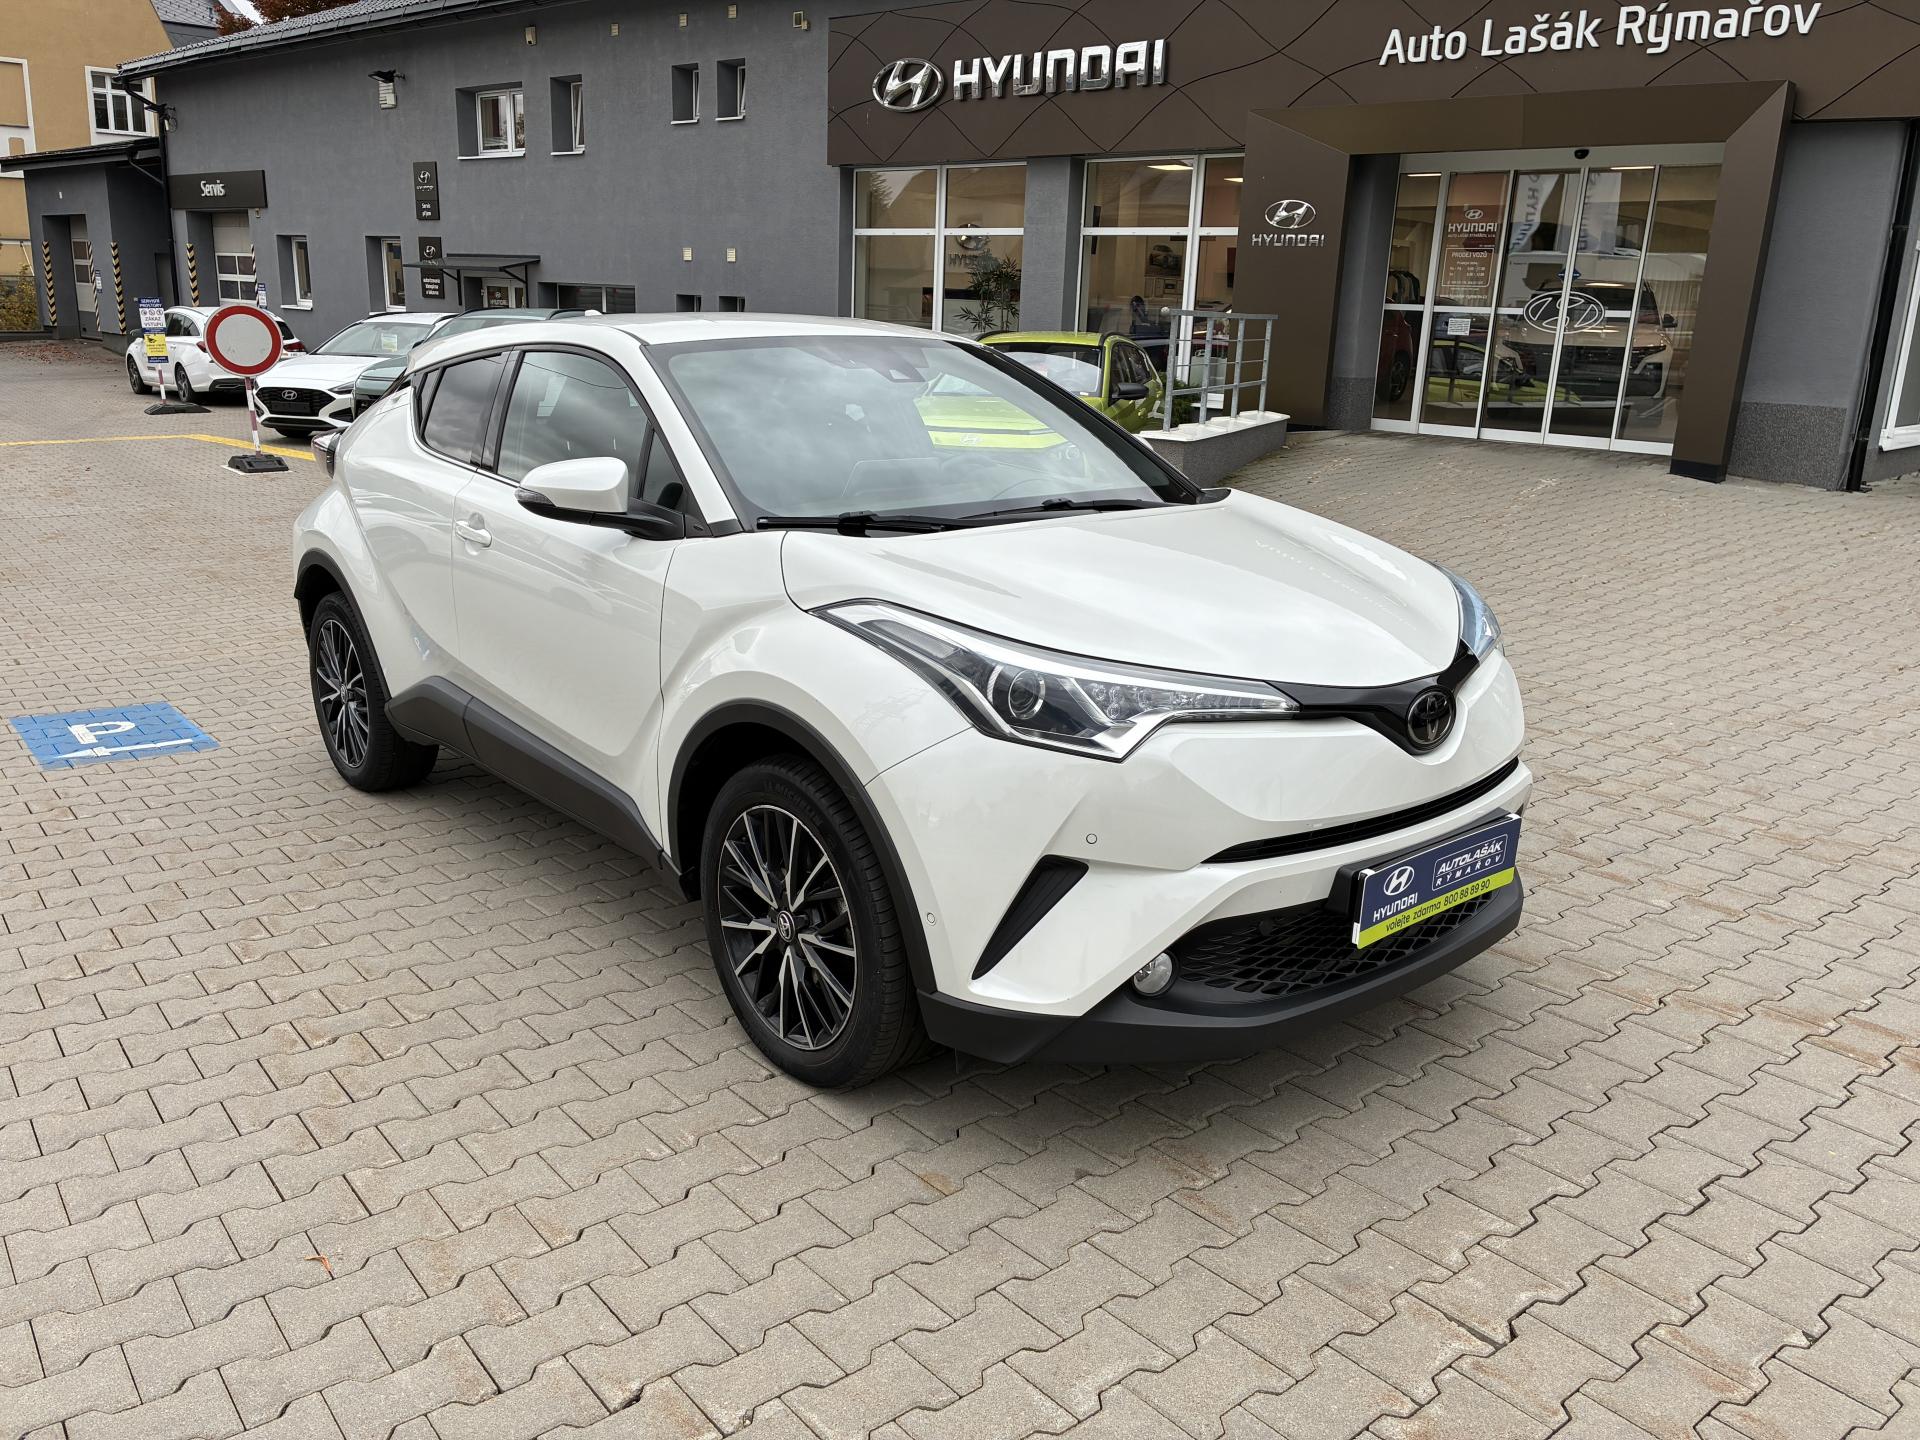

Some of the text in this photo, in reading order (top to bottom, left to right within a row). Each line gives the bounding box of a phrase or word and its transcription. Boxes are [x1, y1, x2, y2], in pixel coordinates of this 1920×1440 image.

[1378, 0, 1822, 66] Auto Lašák Rýmařov
[953, 38, 1166, 100] HYUNDAI
[200, 179, 226, 197] Servis
[1251, 233, 1325, 247] HYUNDAI
[1447, 222, 1498, 233] HYUNDAI
[67, 721, 136, 745] P
[1436, 855, 1502, 887] RÝMAŘOV
[1437, 839, 1503, 875] AUTOLAŠÁK
[1372, 892, 1419, 923] HYUNDAI
[1386, 879, 1491, 932] volejte zdarma 800 88 89 90
